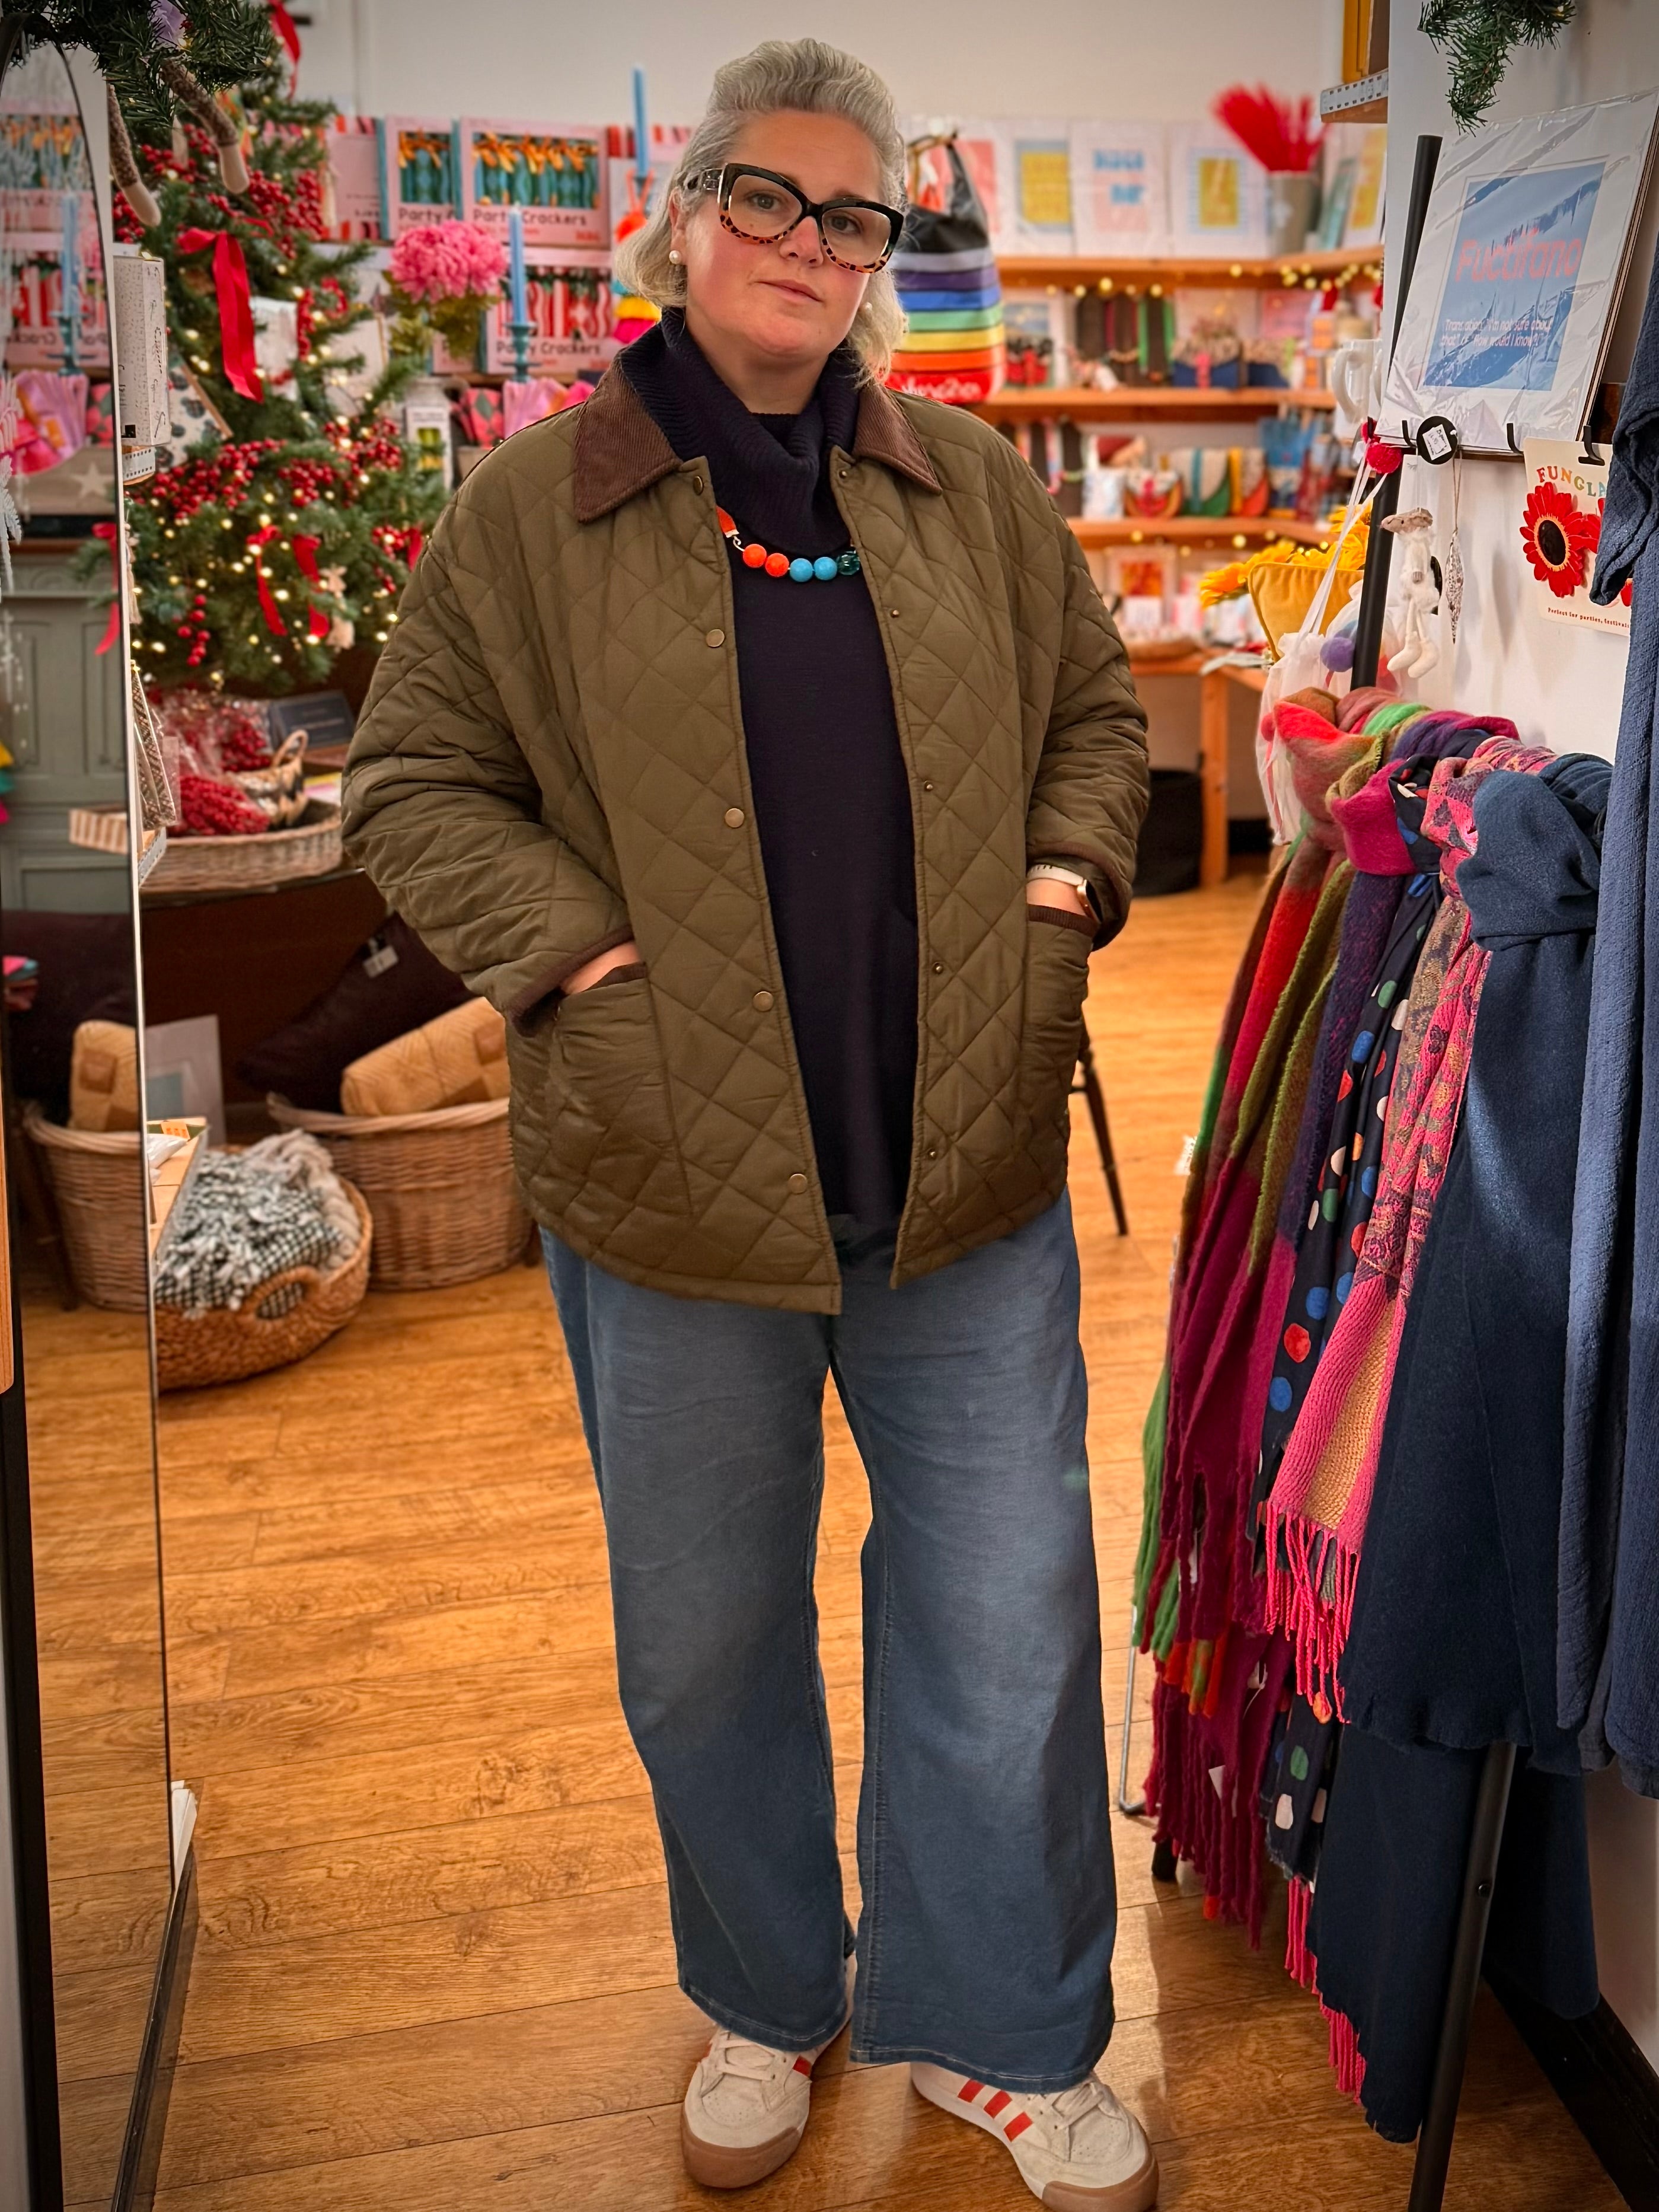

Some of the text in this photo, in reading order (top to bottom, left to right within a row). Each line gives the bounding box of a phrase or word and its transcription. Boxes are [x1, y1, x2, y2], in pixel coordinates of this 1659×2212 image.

[398, 208, 442, 225] Party
[473, 209, 586, 225] Part Crackers
[1514, 320, 1530, 331] sure
[497, 340, 600, 356] Pay Crackers
[1548, 607, 1568, 616] Perfect
[1580, 614, 1603, 624] parties,
